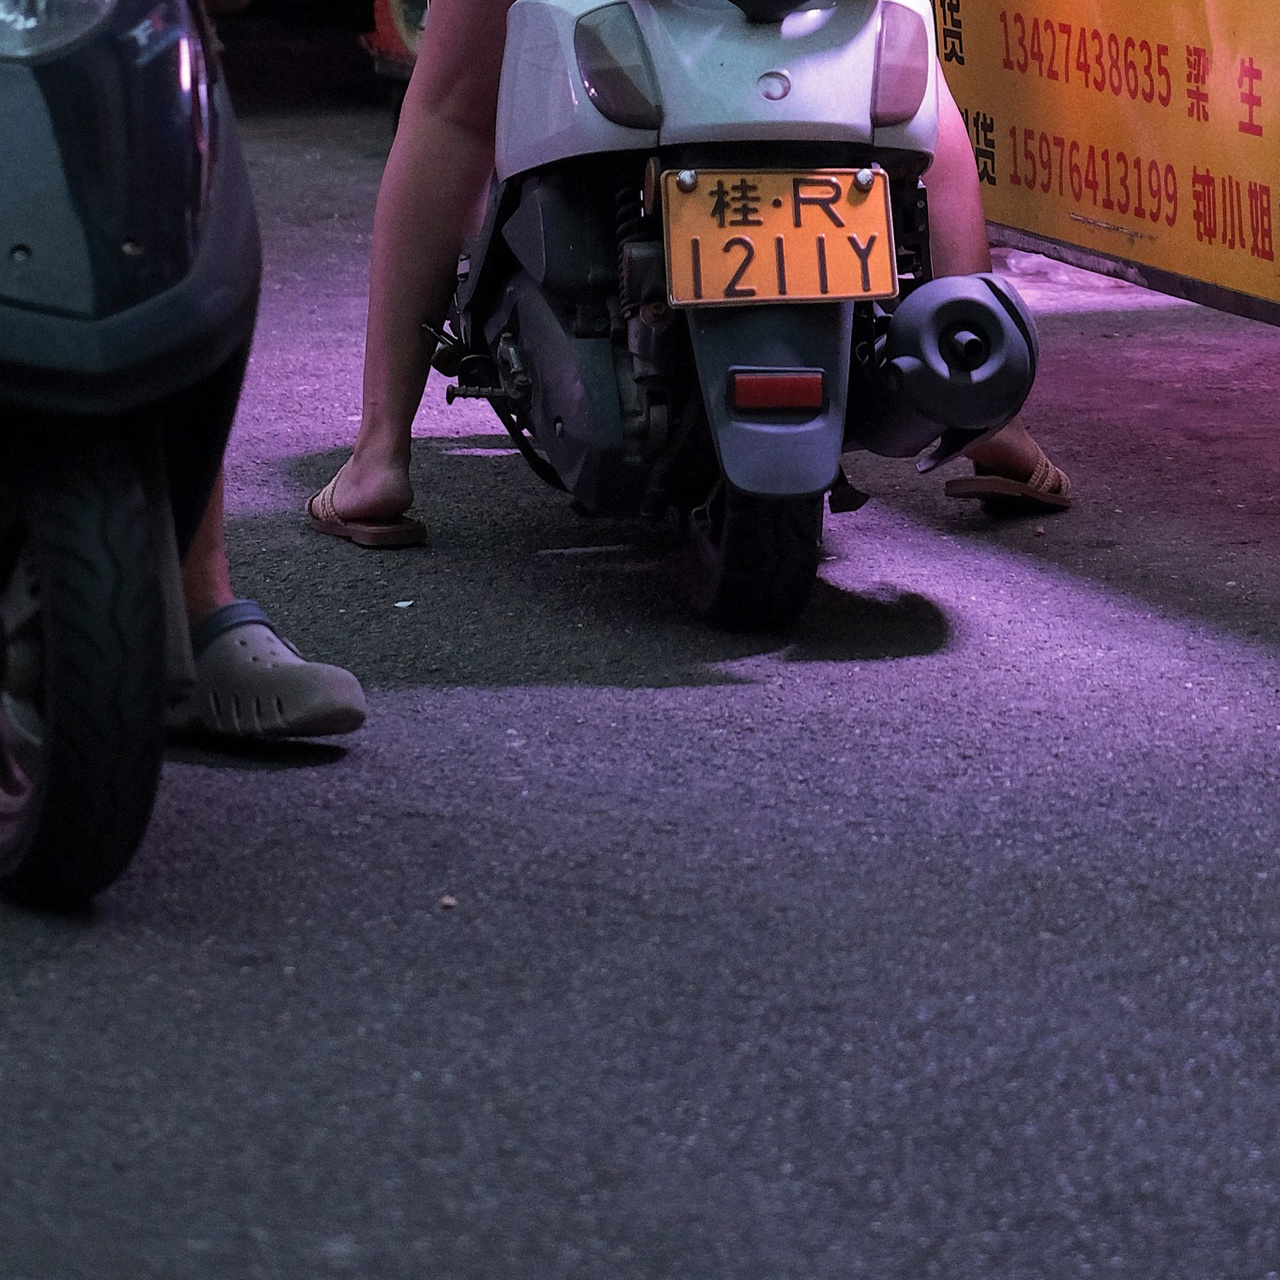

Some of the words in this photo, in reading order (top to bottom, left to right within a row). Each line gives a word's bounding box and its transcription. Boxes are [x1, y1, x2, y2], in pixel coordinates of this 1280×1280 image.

[1000, 11, 1171, 107] 13427438635
[961, 108, 997, 187] 货
[1009, 126, 1179, 228] 15976413199
[1191, 166, 1275, 262] 钟小姐
[690, 233, 878, 300] 1211Y
